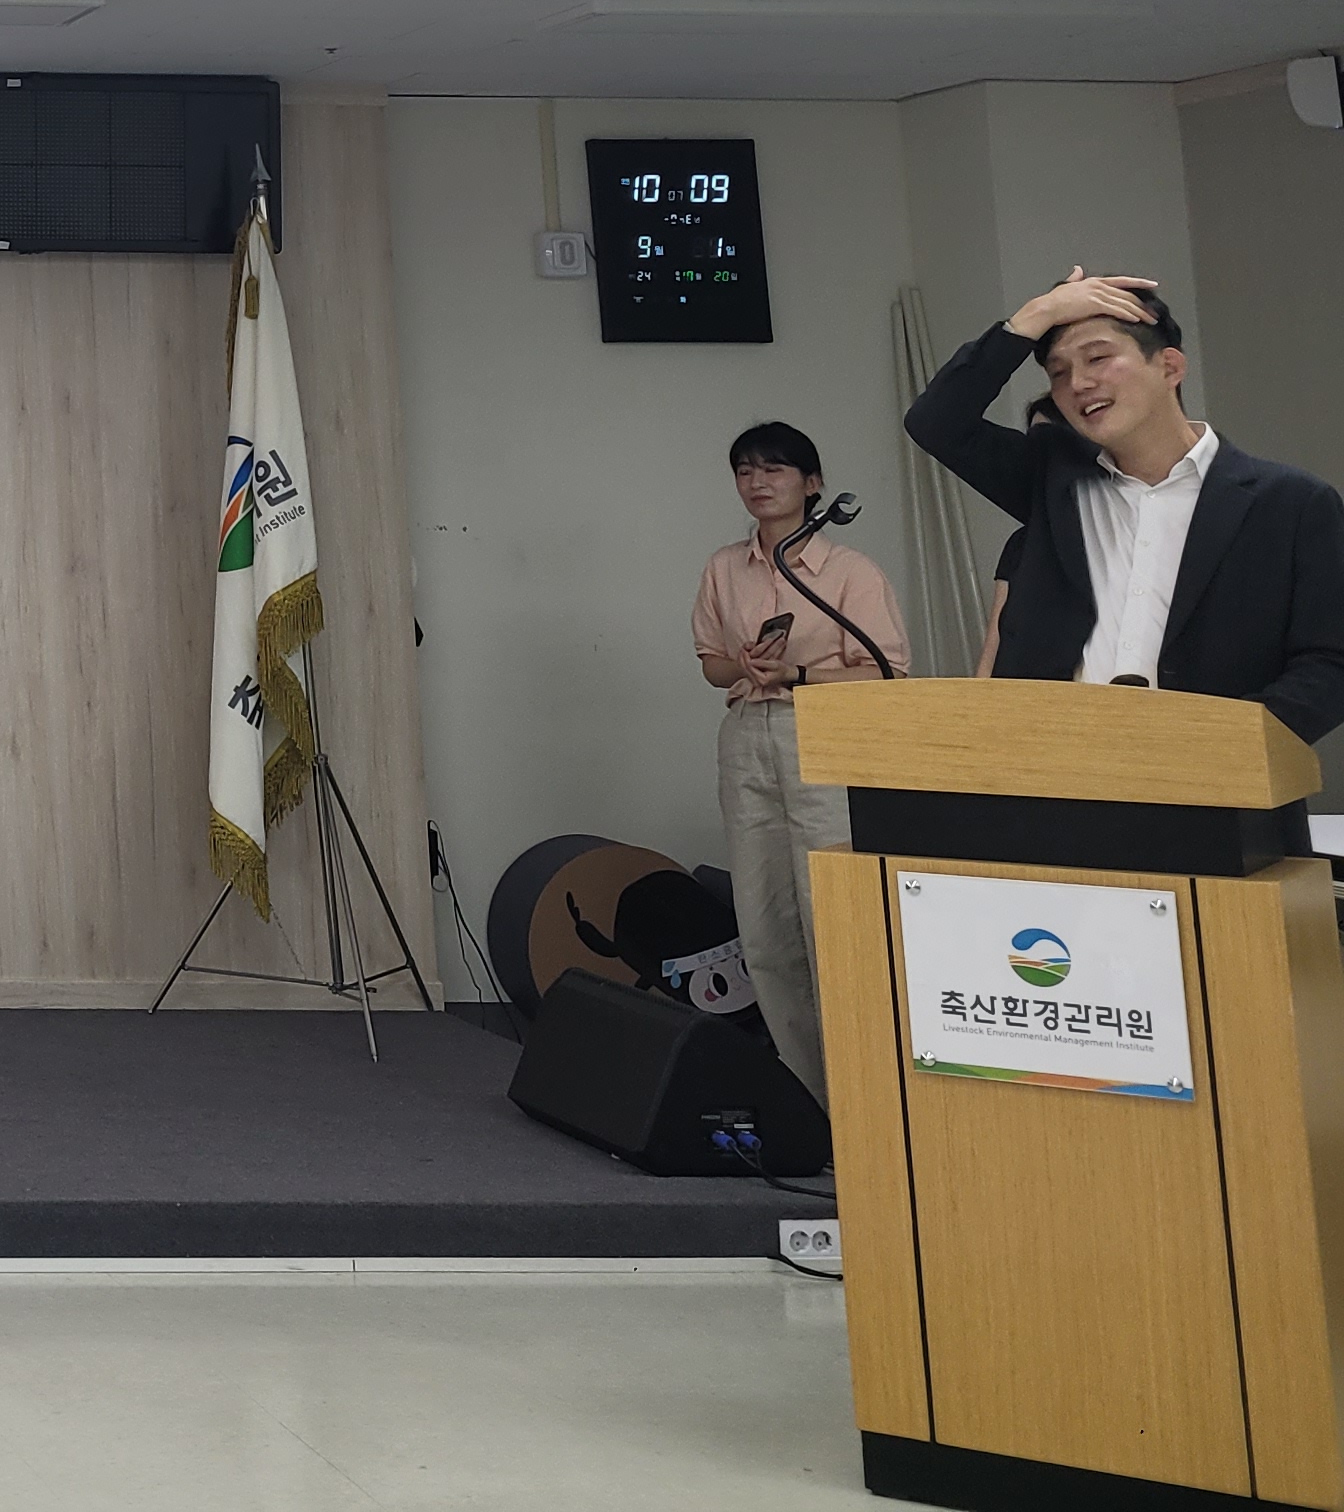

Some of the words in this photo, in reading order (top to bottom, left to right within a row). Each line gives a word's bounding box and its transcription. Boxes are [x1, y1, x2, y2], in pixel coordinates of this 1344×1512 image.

[633, 174, 661, 203] 10
[689, 174, 730, 203] 09
[258, 504, 306, 538] Institute
[940, 990, 1154, 1041] 축산환경관리원
[942, 1023, 985, 1036] Livestock
[986, 1028, 1053, 1043] Environmental
[1054, 1035, 1114, 1049] Management
[1116, 1041, 1155, 1053] Institute
